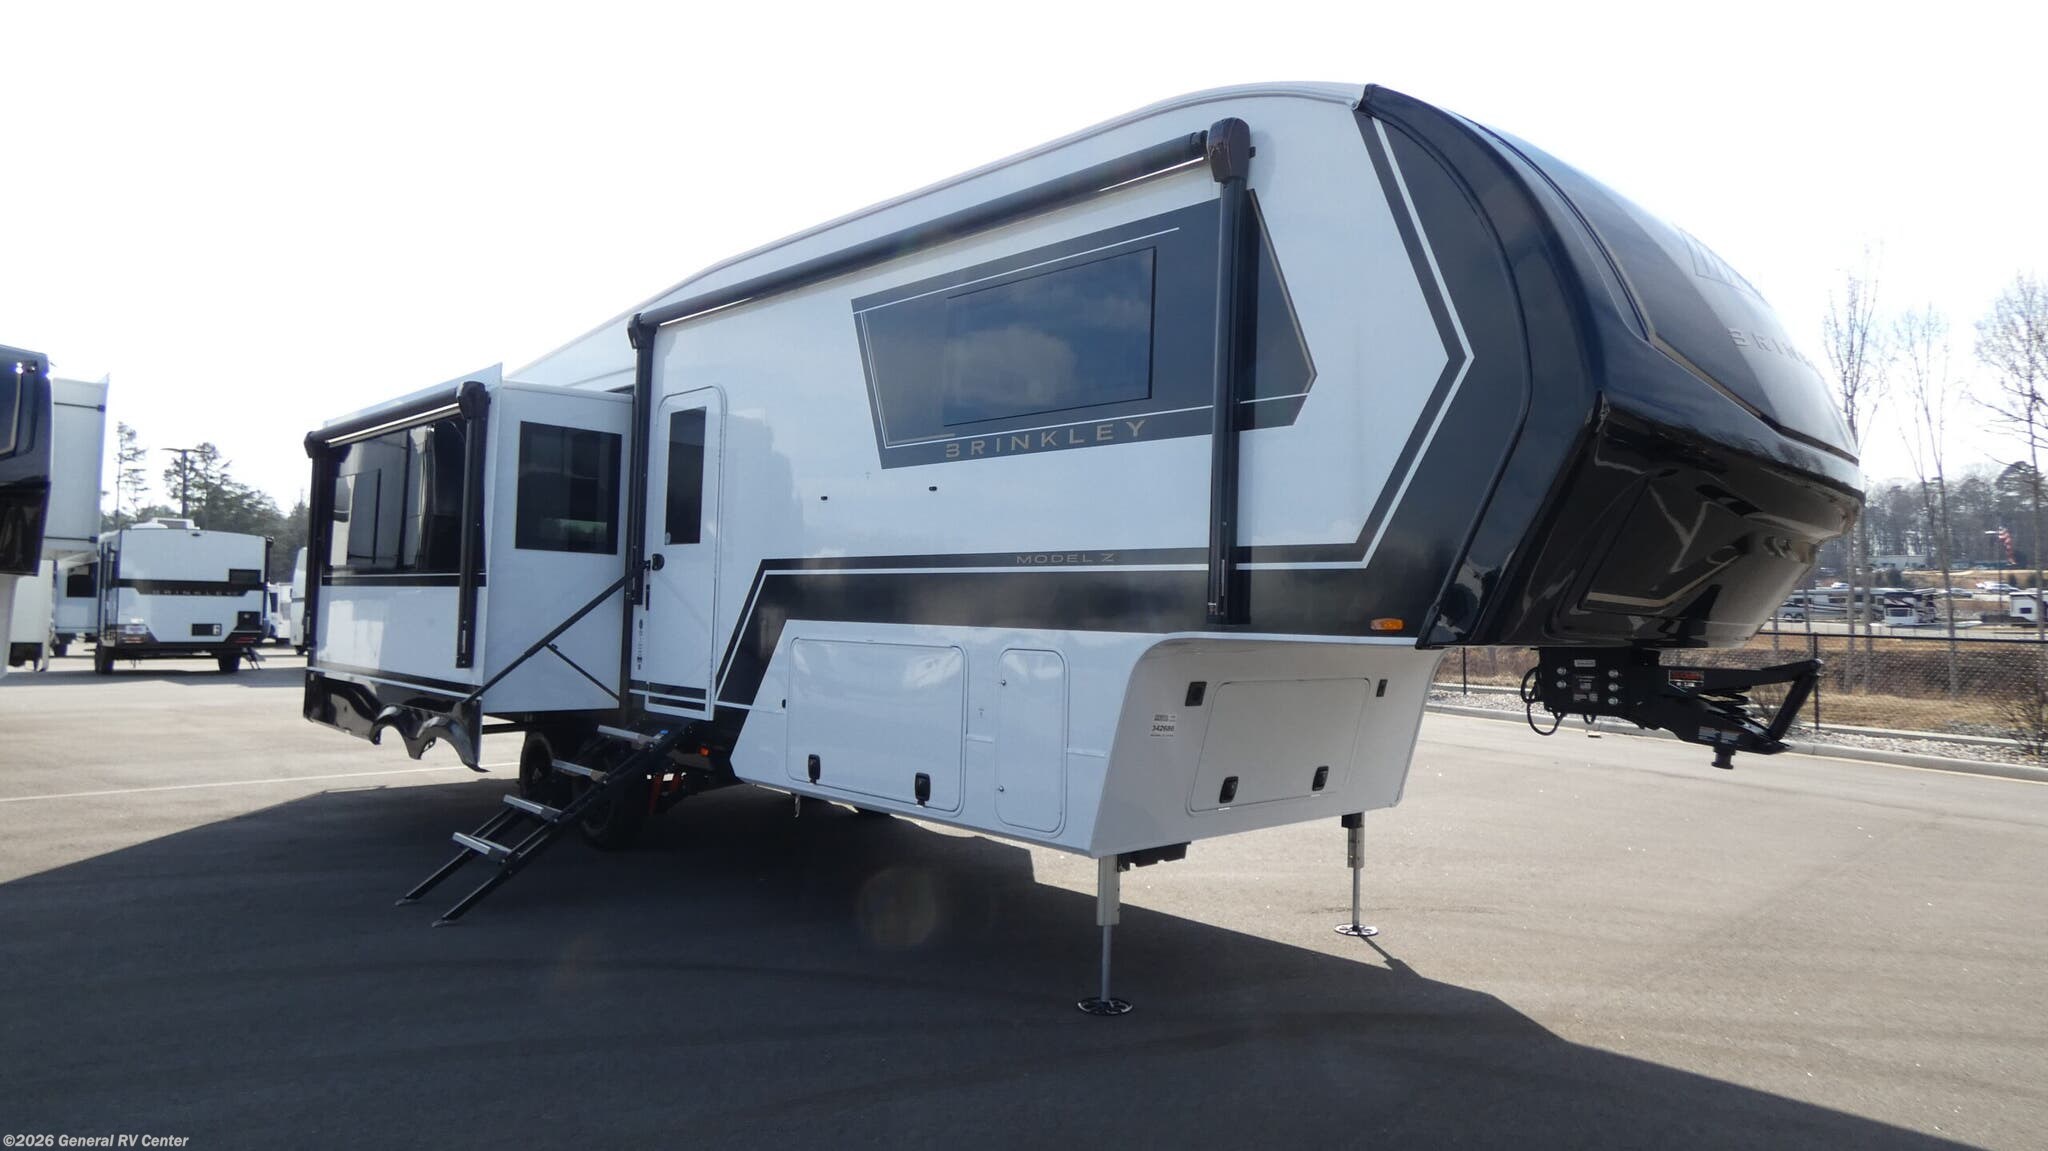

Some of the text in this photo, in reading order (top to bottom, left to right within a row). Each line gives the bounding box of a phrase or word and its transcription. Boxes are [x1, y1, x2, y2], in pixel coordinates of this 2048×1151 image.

[945, 420, 1146, 458] BRINKLEY
[1016, 552, 1115, 565] MODEL Z
